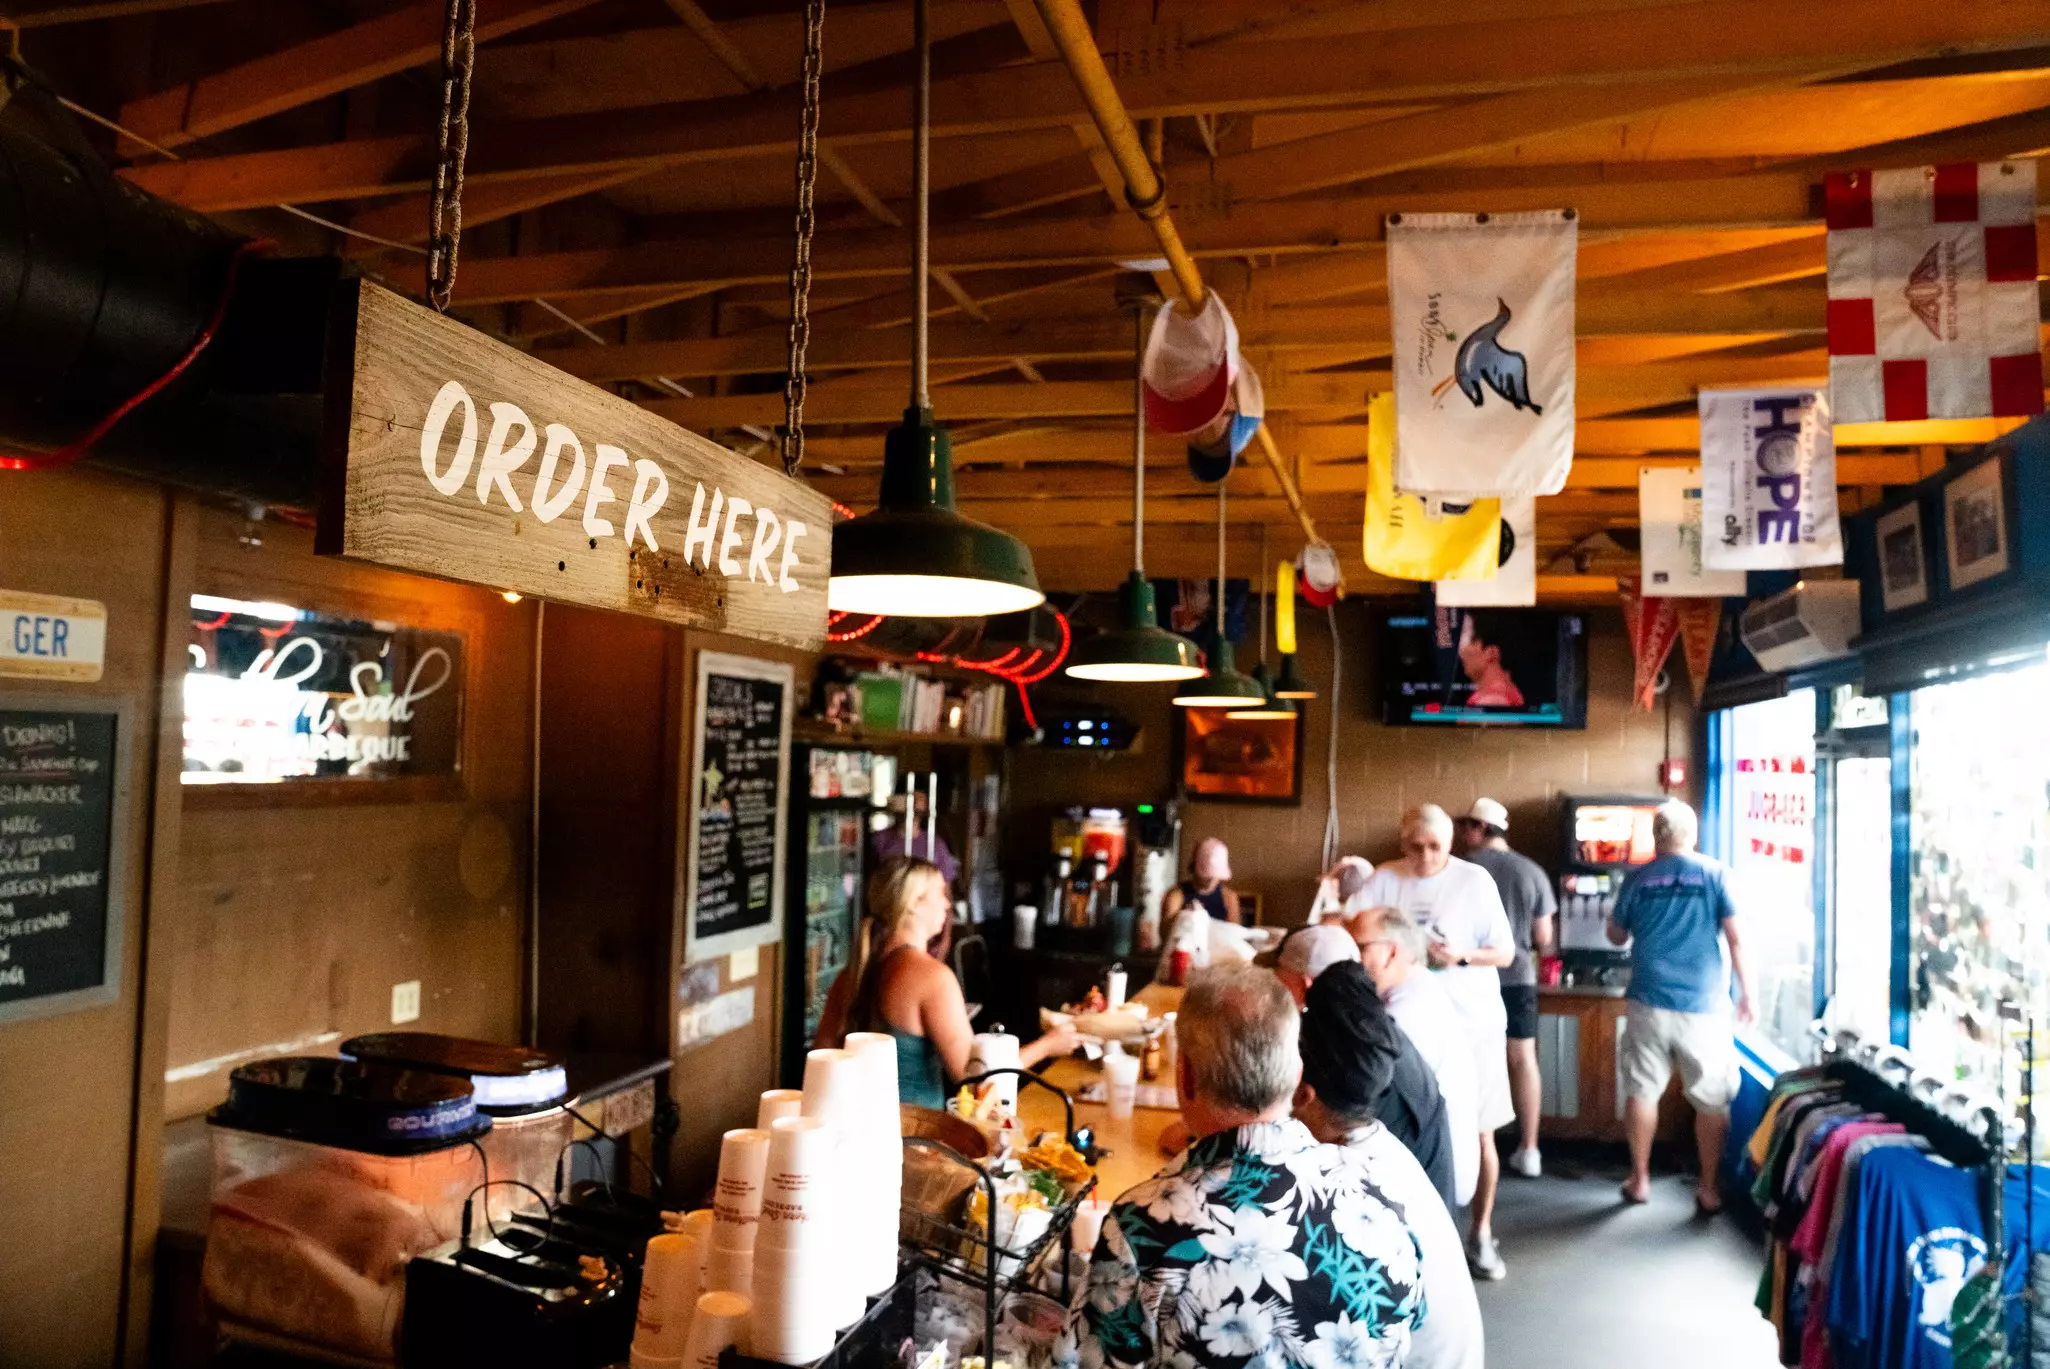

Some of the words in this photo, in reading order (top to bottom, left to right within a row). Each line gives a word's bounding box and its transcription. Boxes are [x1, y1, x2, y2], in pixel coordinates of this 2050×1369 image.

[421, 381, 669, 553] ORDER
[684, 482, 807, 594] HERE
[1754, 397, 1801, 545] HOPE
[1721, 514, 1742, 546] ally
[15, 615, 69, 657] GER
